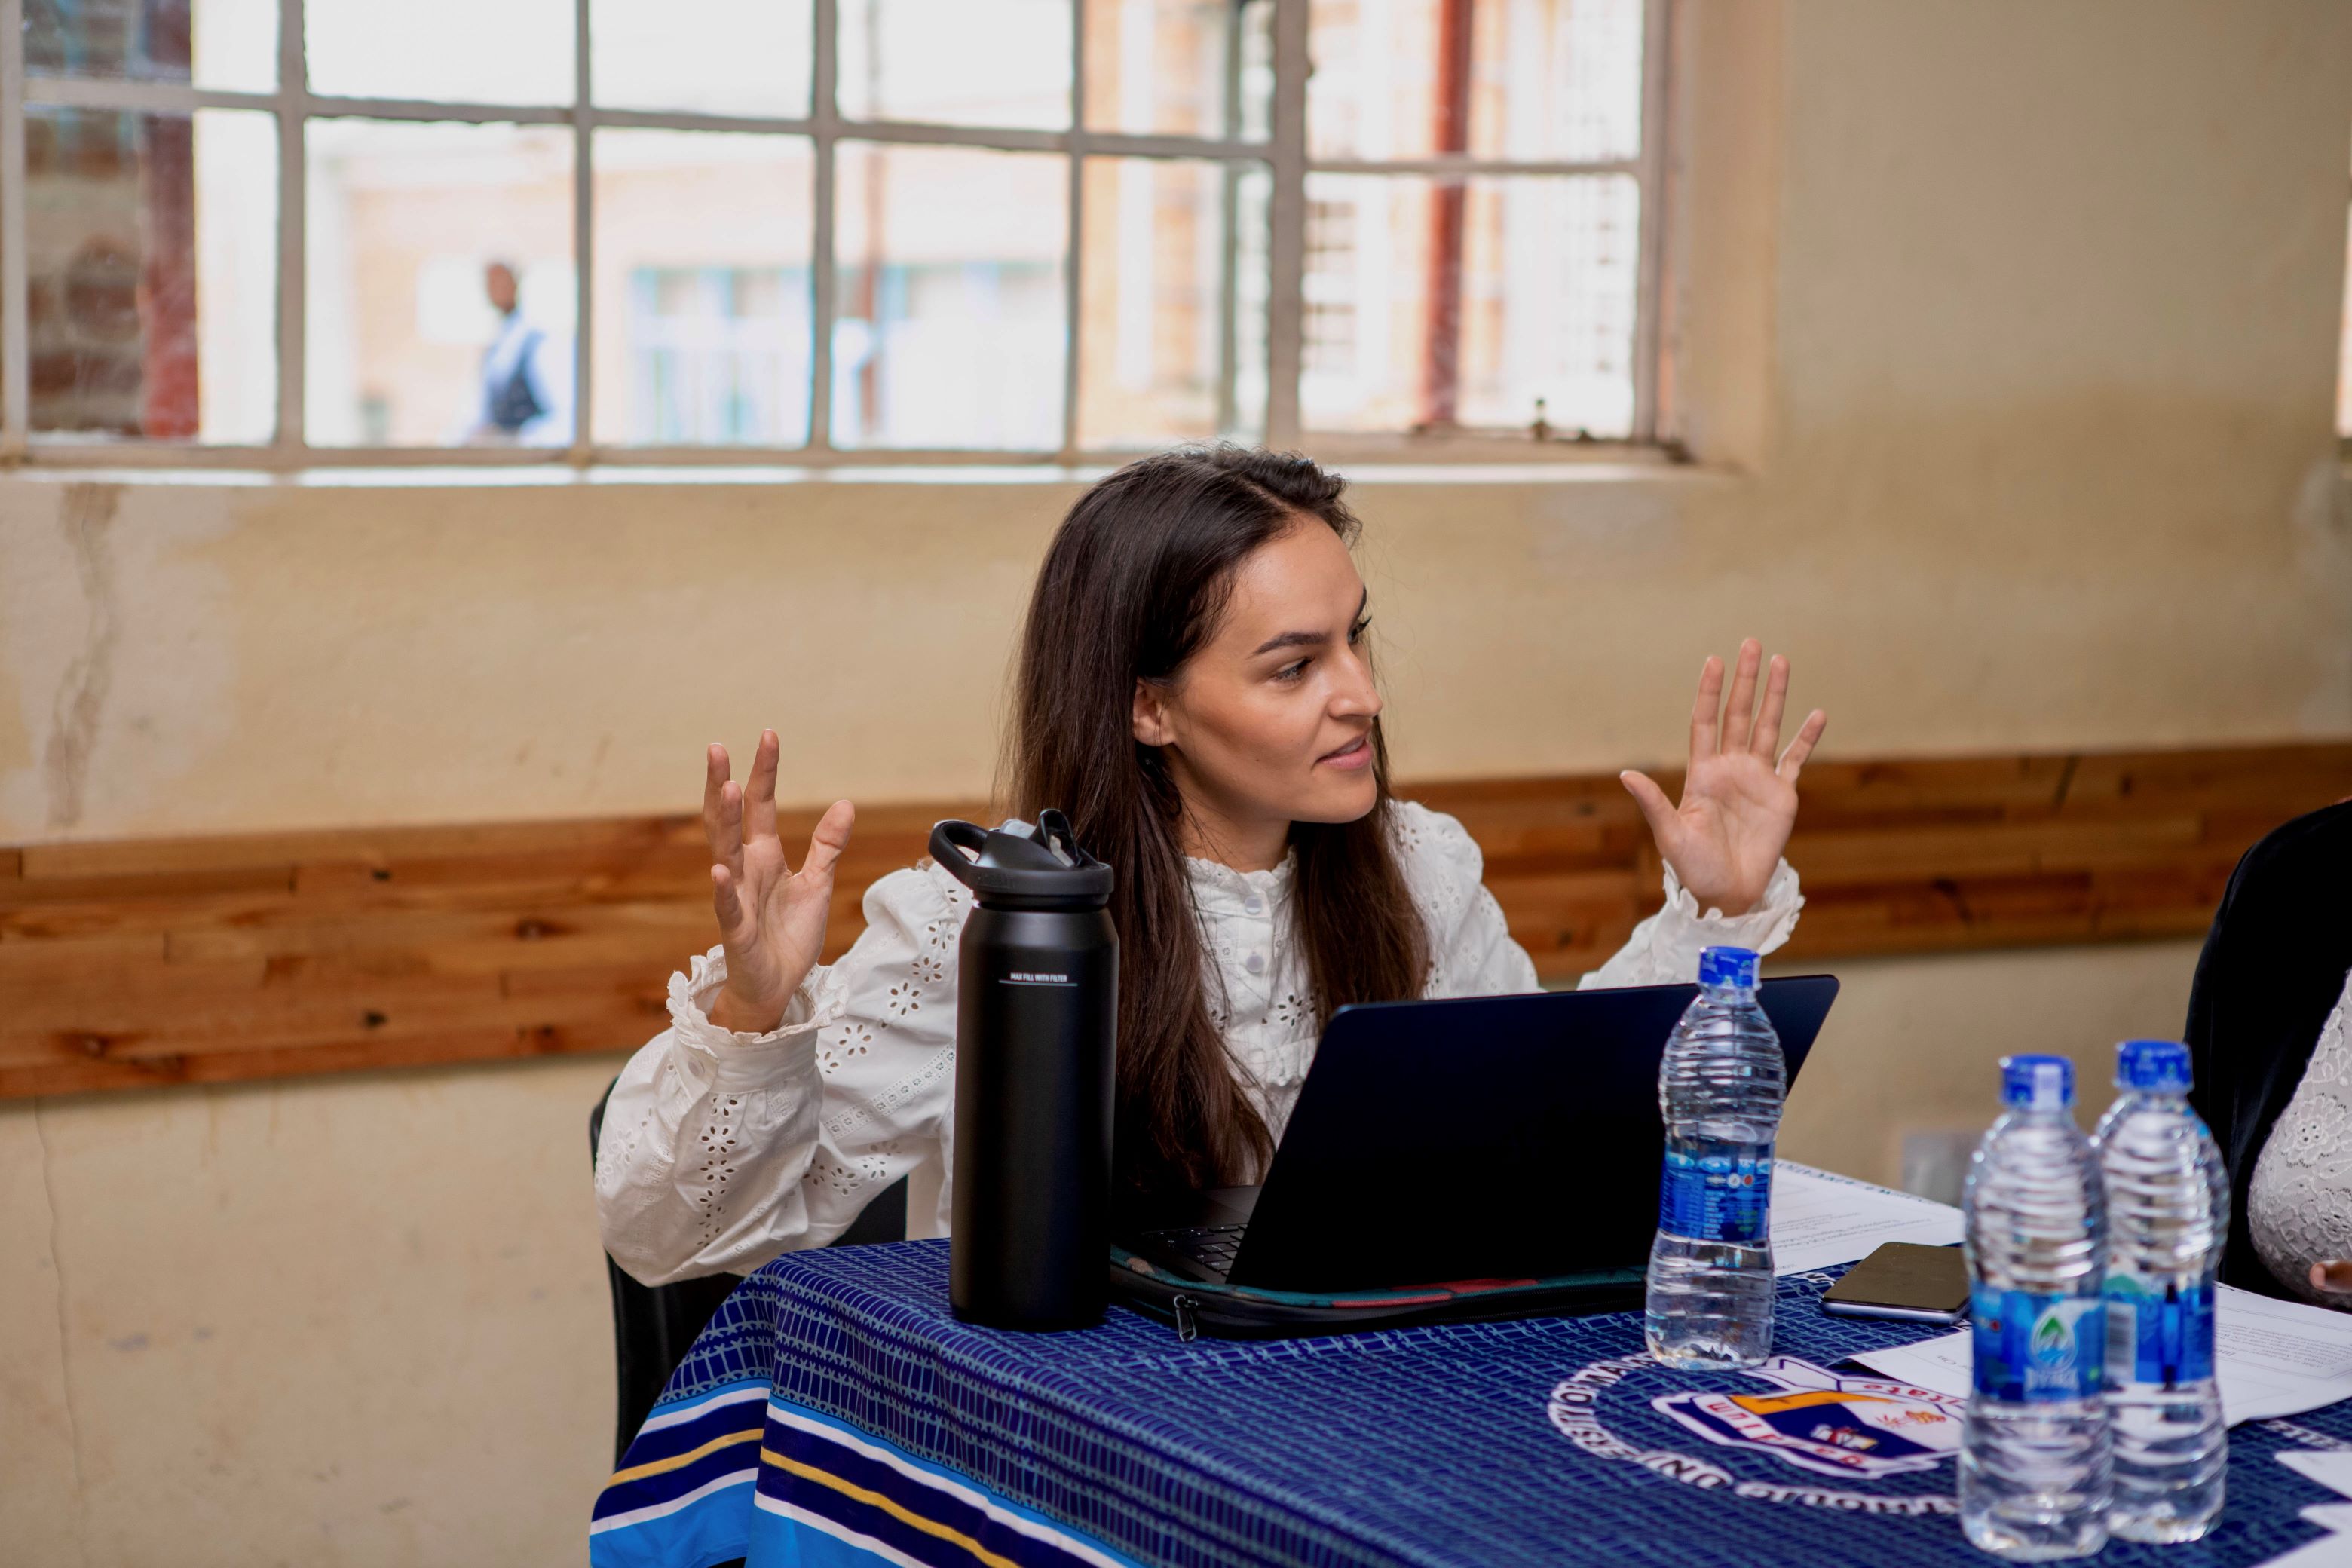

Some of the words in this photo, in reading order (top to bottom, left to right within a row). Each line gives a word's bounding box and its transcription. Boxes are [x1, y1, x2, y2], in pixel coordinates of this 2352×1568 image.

[1010, 972, 1022, 981] MAX
[1023, 973, 1034, 982] FILL
[1035, 973, 1049, 982] WITH
[1050, 974, 1067, 982] FILTER
[1736, 1484, 1959, 1515] THOLIC
